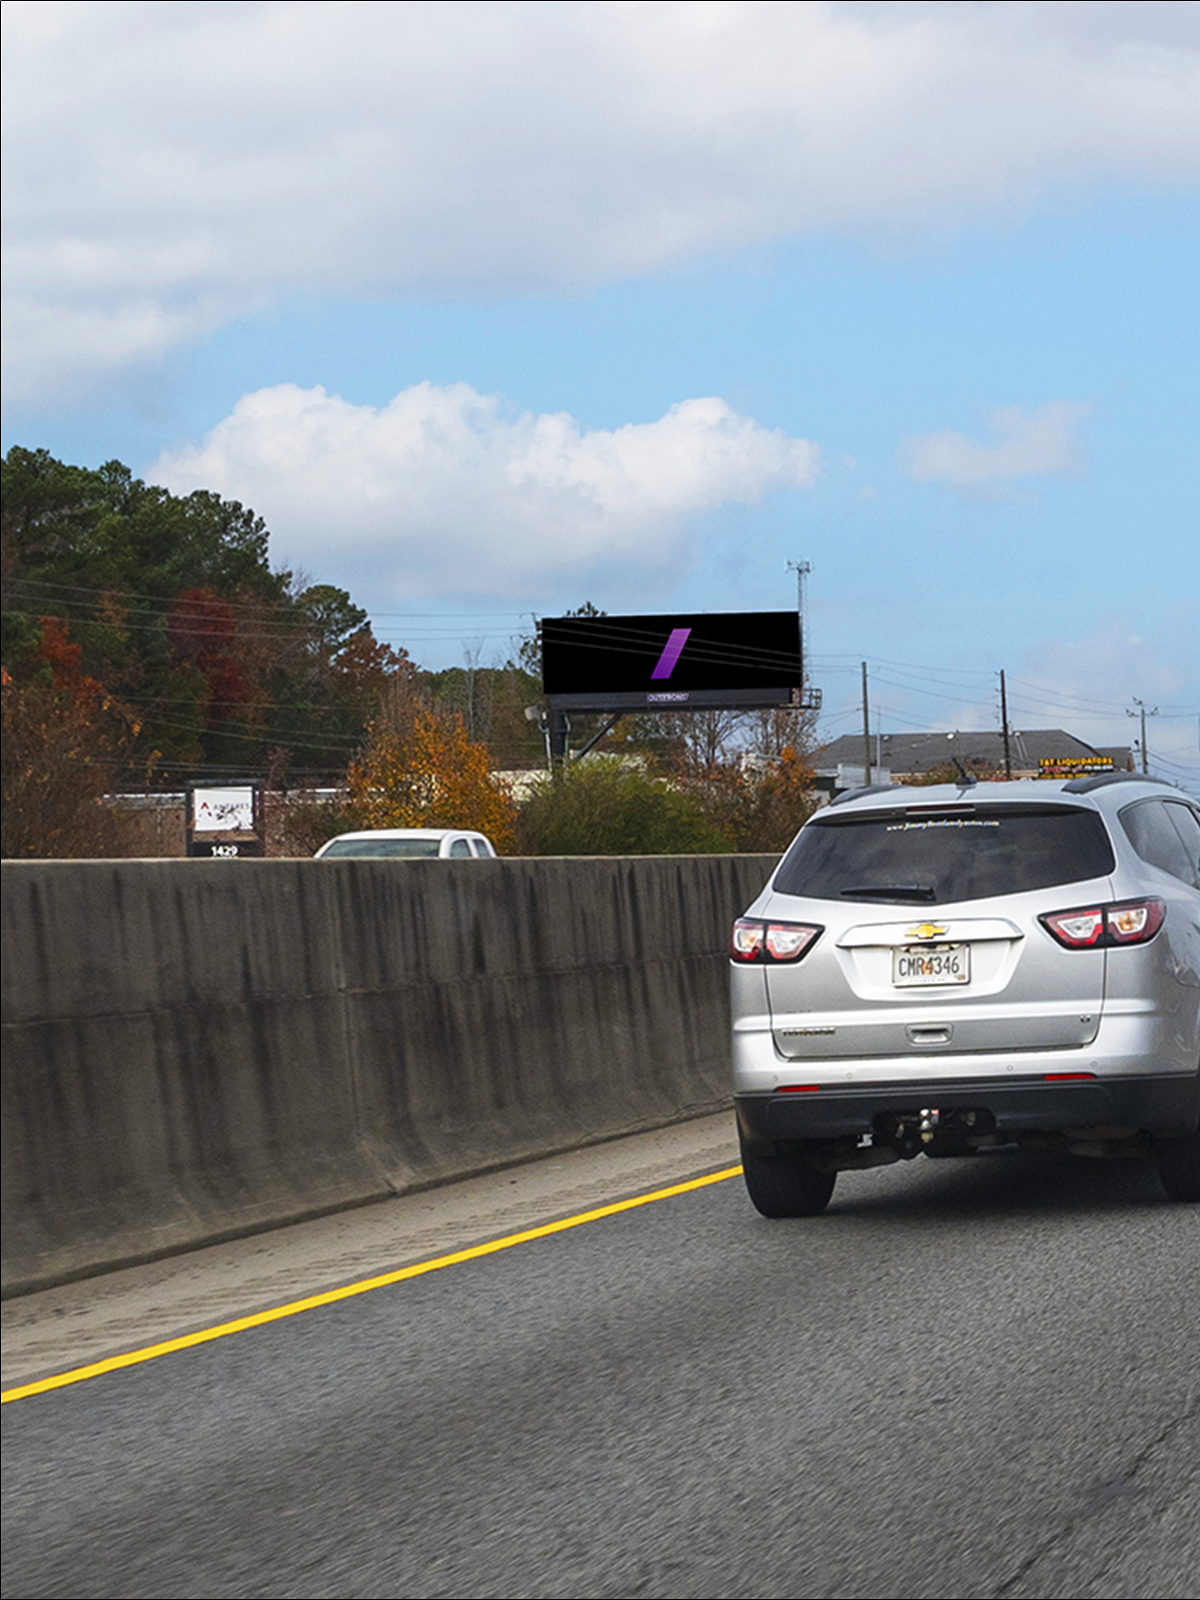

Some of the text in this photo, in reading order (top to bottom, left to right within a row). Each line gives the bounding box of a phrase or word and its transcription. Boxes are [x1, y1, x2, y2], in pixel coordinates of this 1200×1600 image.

[1056, 756, 1113, 766] LIQUIDATORS
[211, 845, 239, 858] 1429
[899, 956, 960, 976] CMR4346
